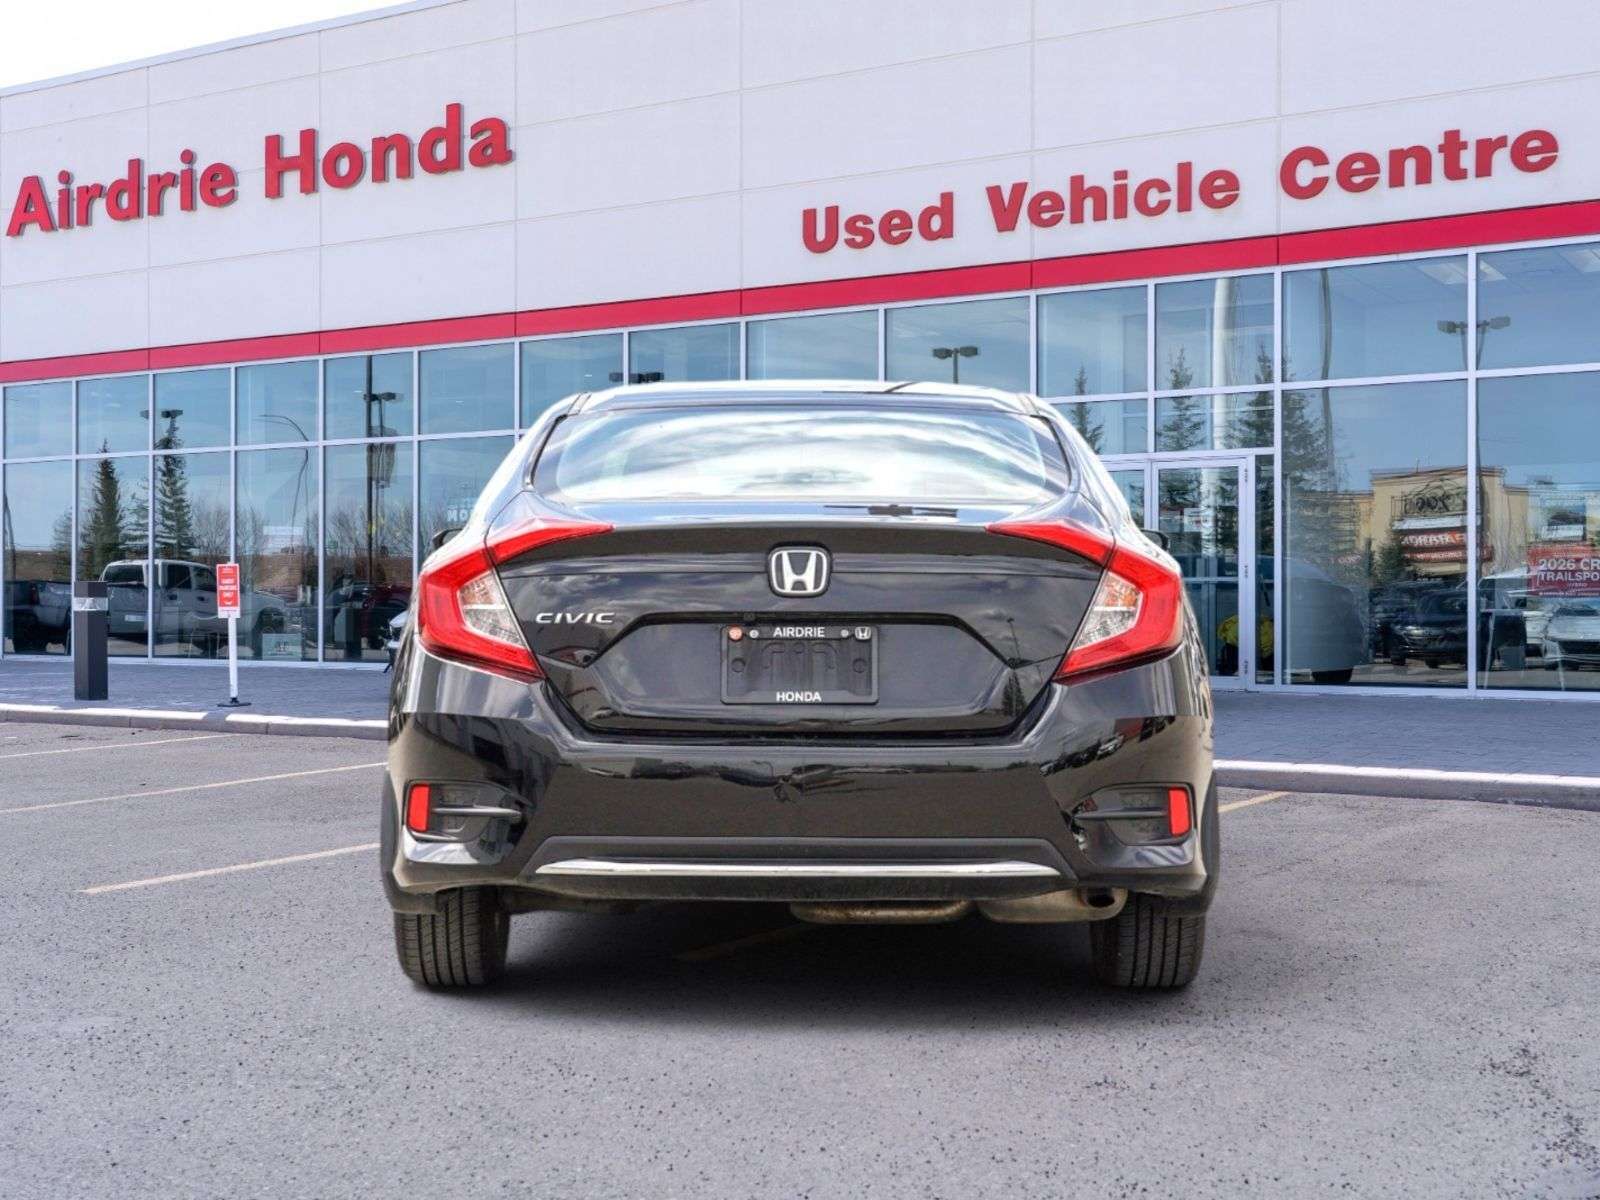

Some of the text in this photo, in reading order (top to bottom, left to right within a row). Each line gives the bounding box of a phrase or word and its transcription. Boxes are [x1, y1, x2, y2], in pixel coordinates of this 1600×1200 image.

[7, 103, 513, 237] Airdrie Honda
[802, 129, 1559, 253] Used Vehicle Centre
[1539, 559, 1576, 571] 2026
[535, 612, 615, 625] CIVIC
[772, 626, 826, 638] AIRDRIE
[775, 691, 822, 702] HONDA
